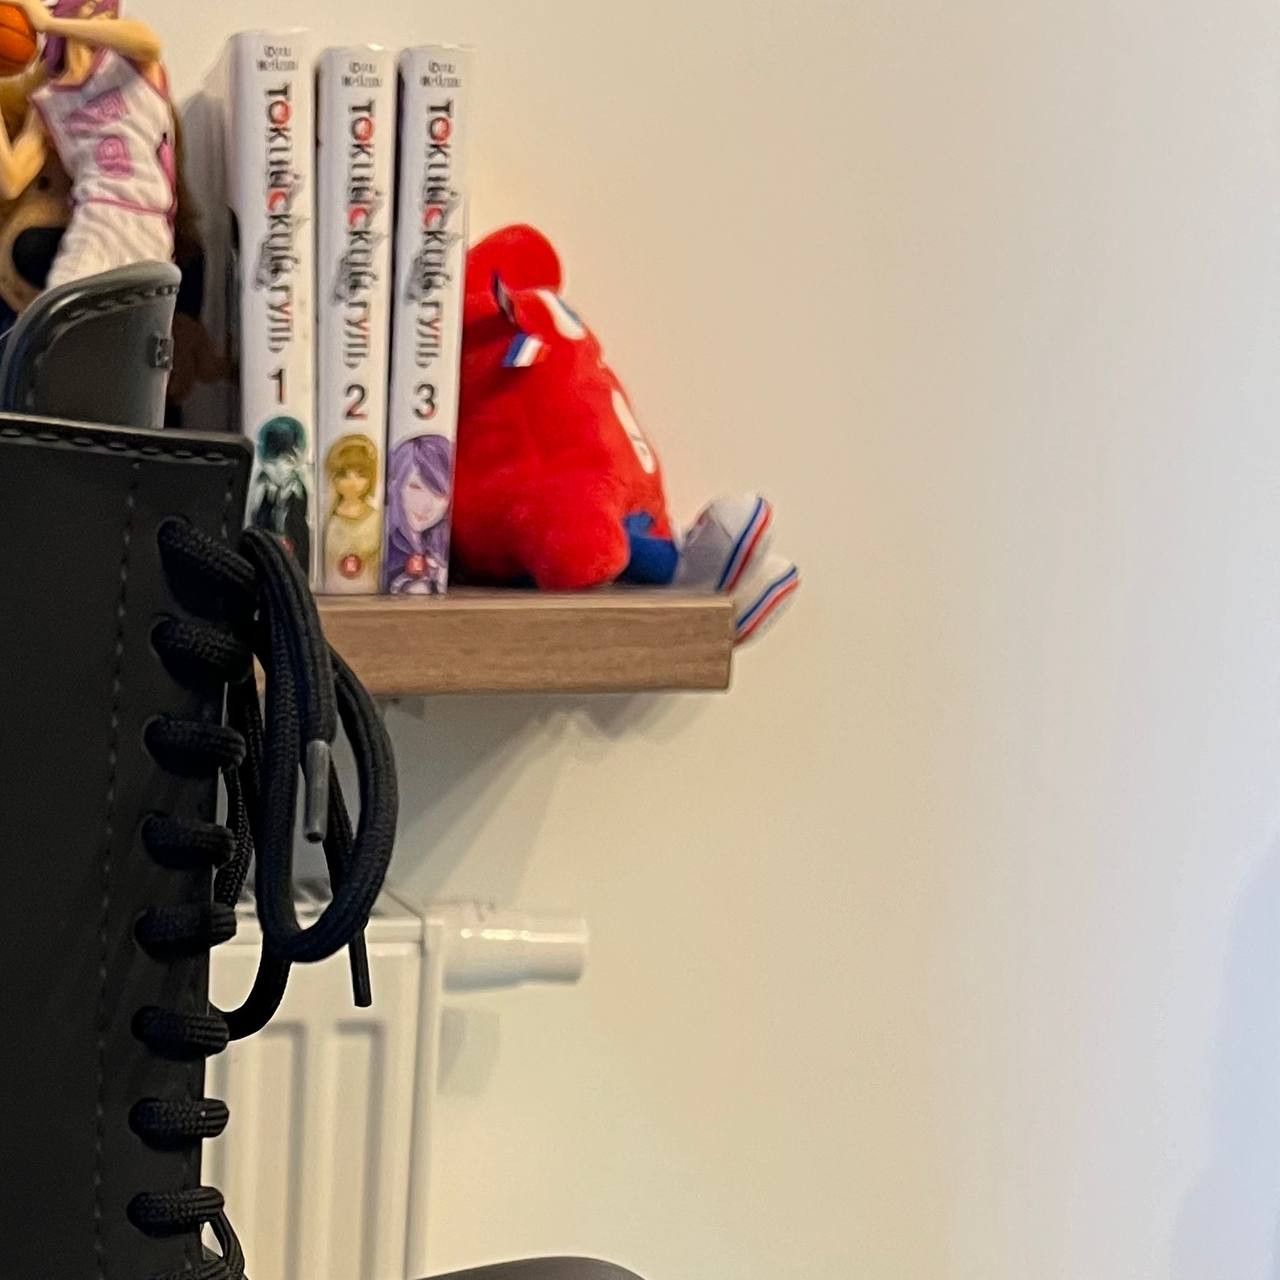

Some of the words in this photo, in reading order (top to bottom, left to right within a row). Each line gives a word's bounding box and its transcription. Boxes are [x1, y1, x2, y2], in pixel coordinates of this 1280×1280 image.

[267, 284, 294, 353] ГУЛЬ
[344, 301, 371, 368] ГУЛЬ
[416, 301, 444, 368] ГУЛЬ
[269, 368, 286, 404] 1
[345, 383, 368, 420] 2
[414, 383, 437, 420] 3
